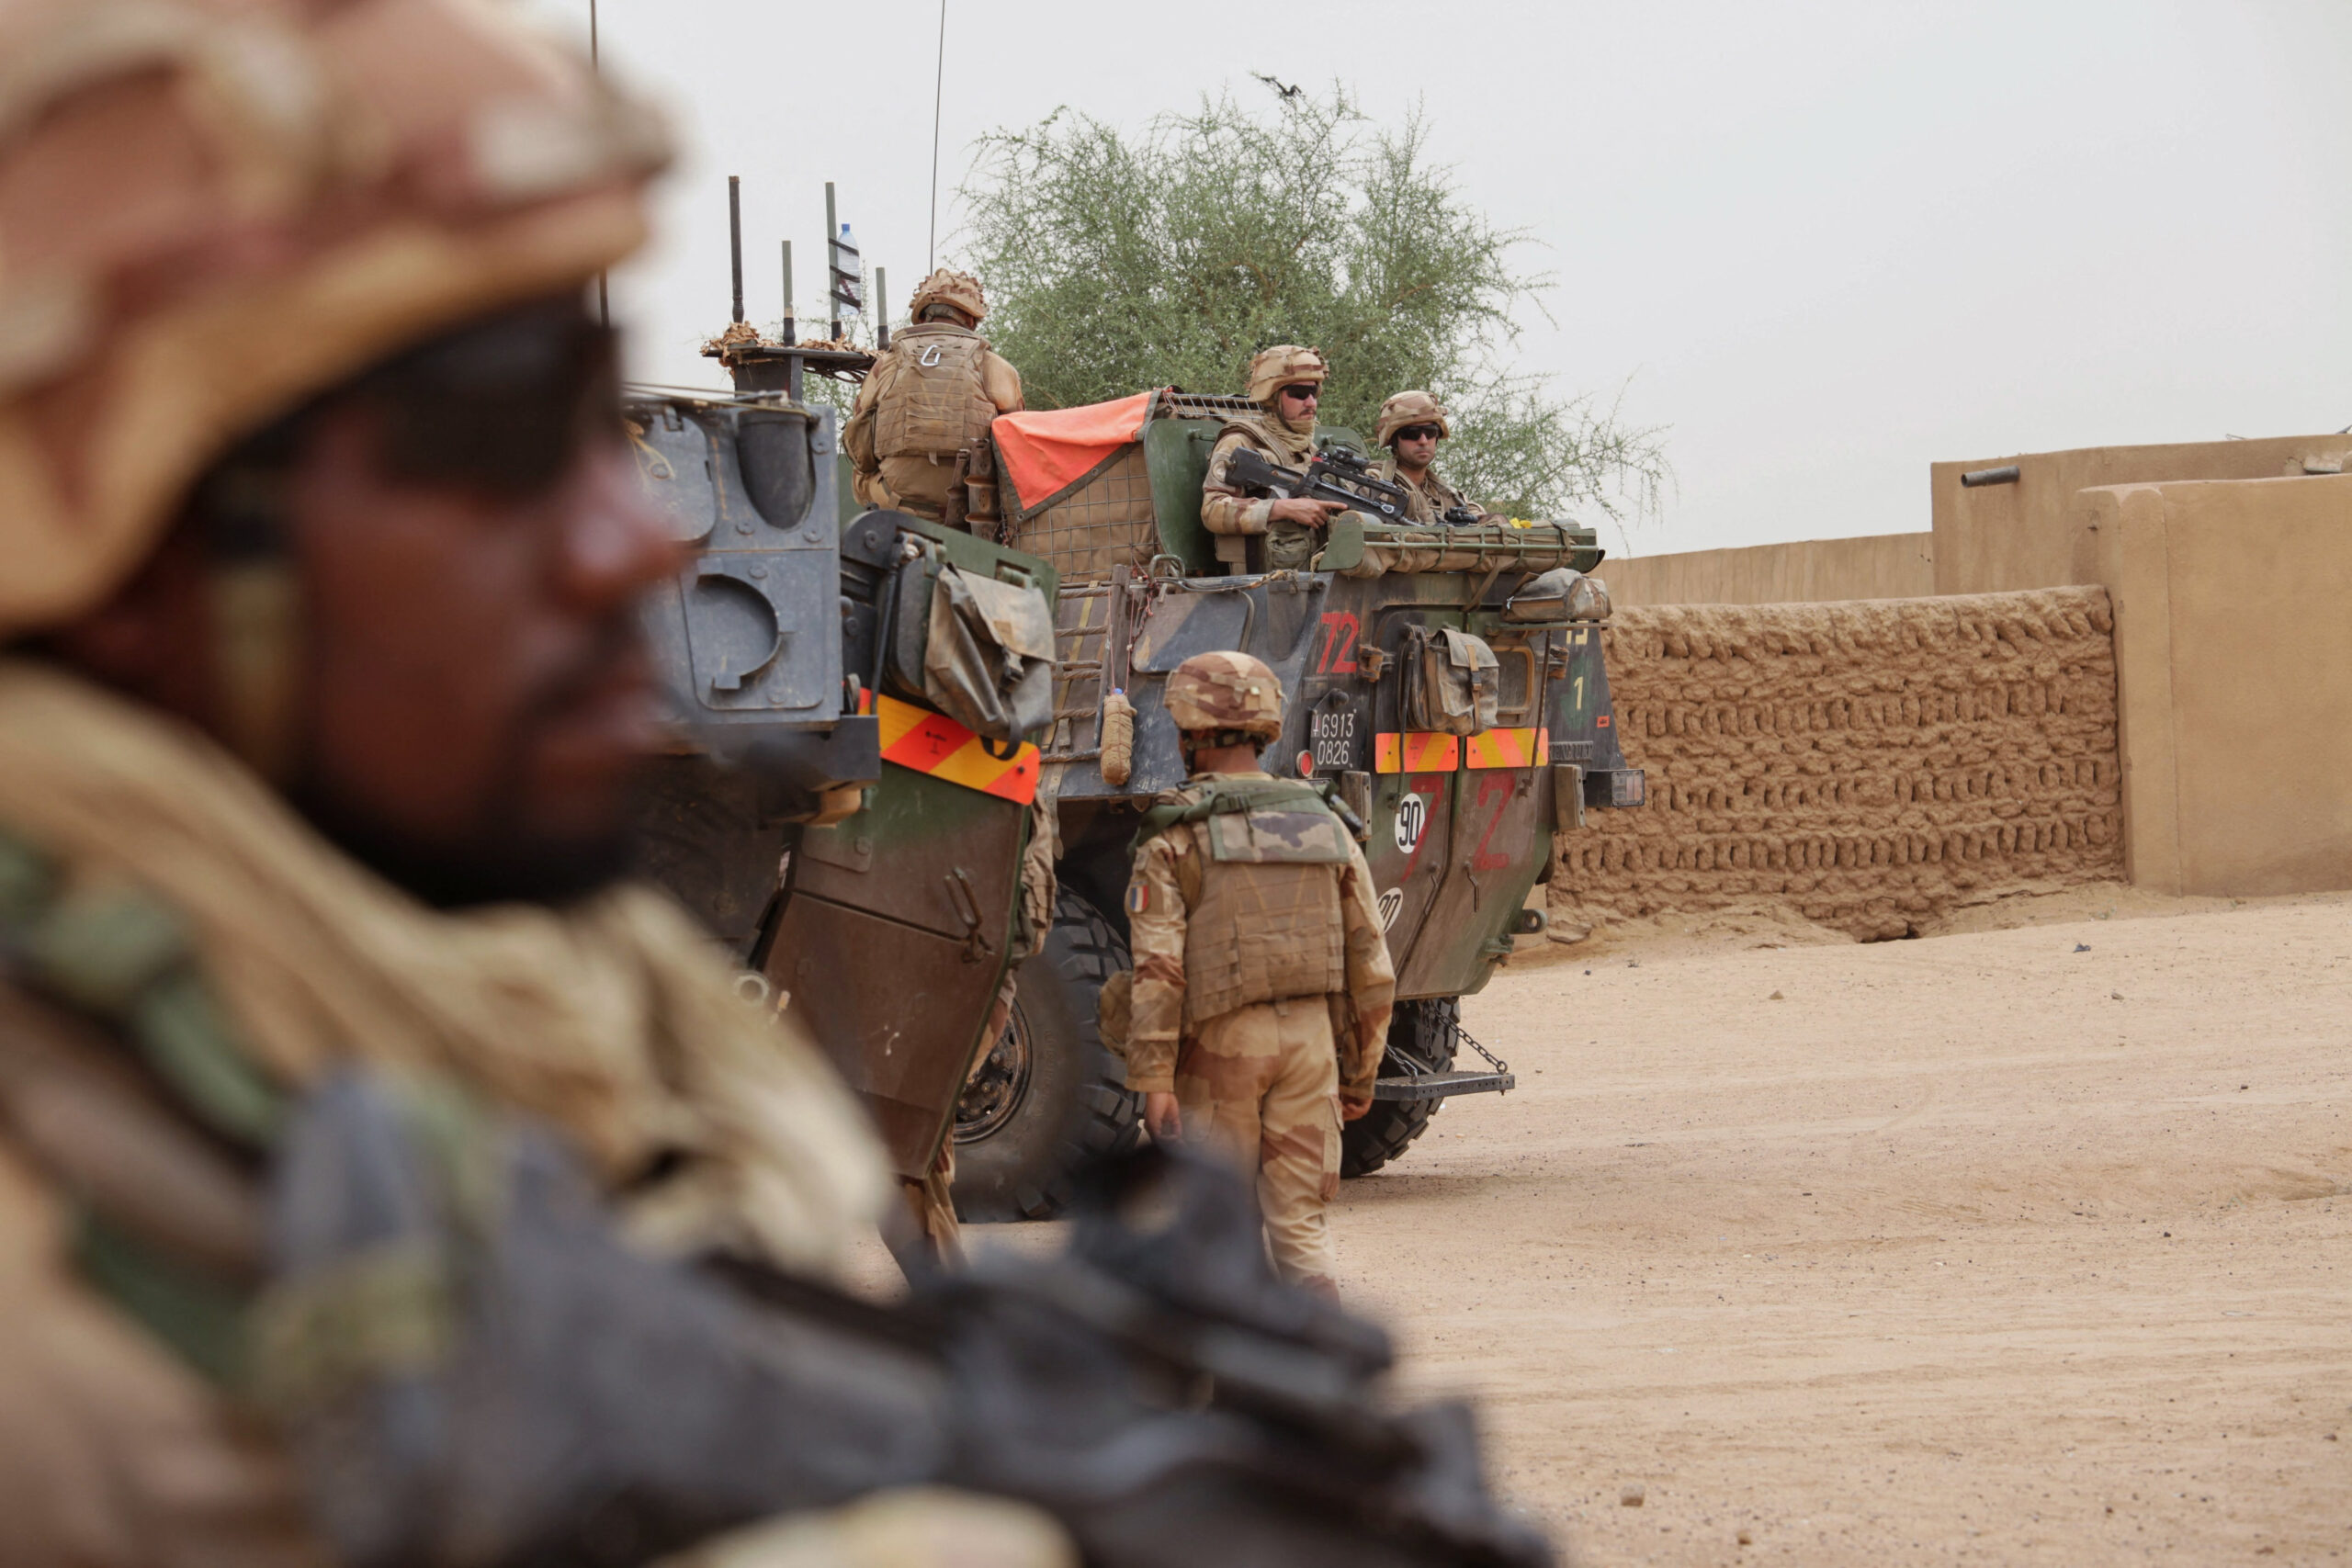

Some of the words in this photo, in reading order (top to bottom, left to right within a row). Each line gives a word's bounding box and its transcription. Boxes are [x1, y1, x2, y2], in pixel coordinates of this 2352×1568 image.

[1317, 611, 1359, 674] 72
[1574, 676, 1584, 711] 1
[1321, 713, 1354, 739] 6913
[1317, 740, 1351, 765] 0826
[1398, 800, 1421, 847] 90
